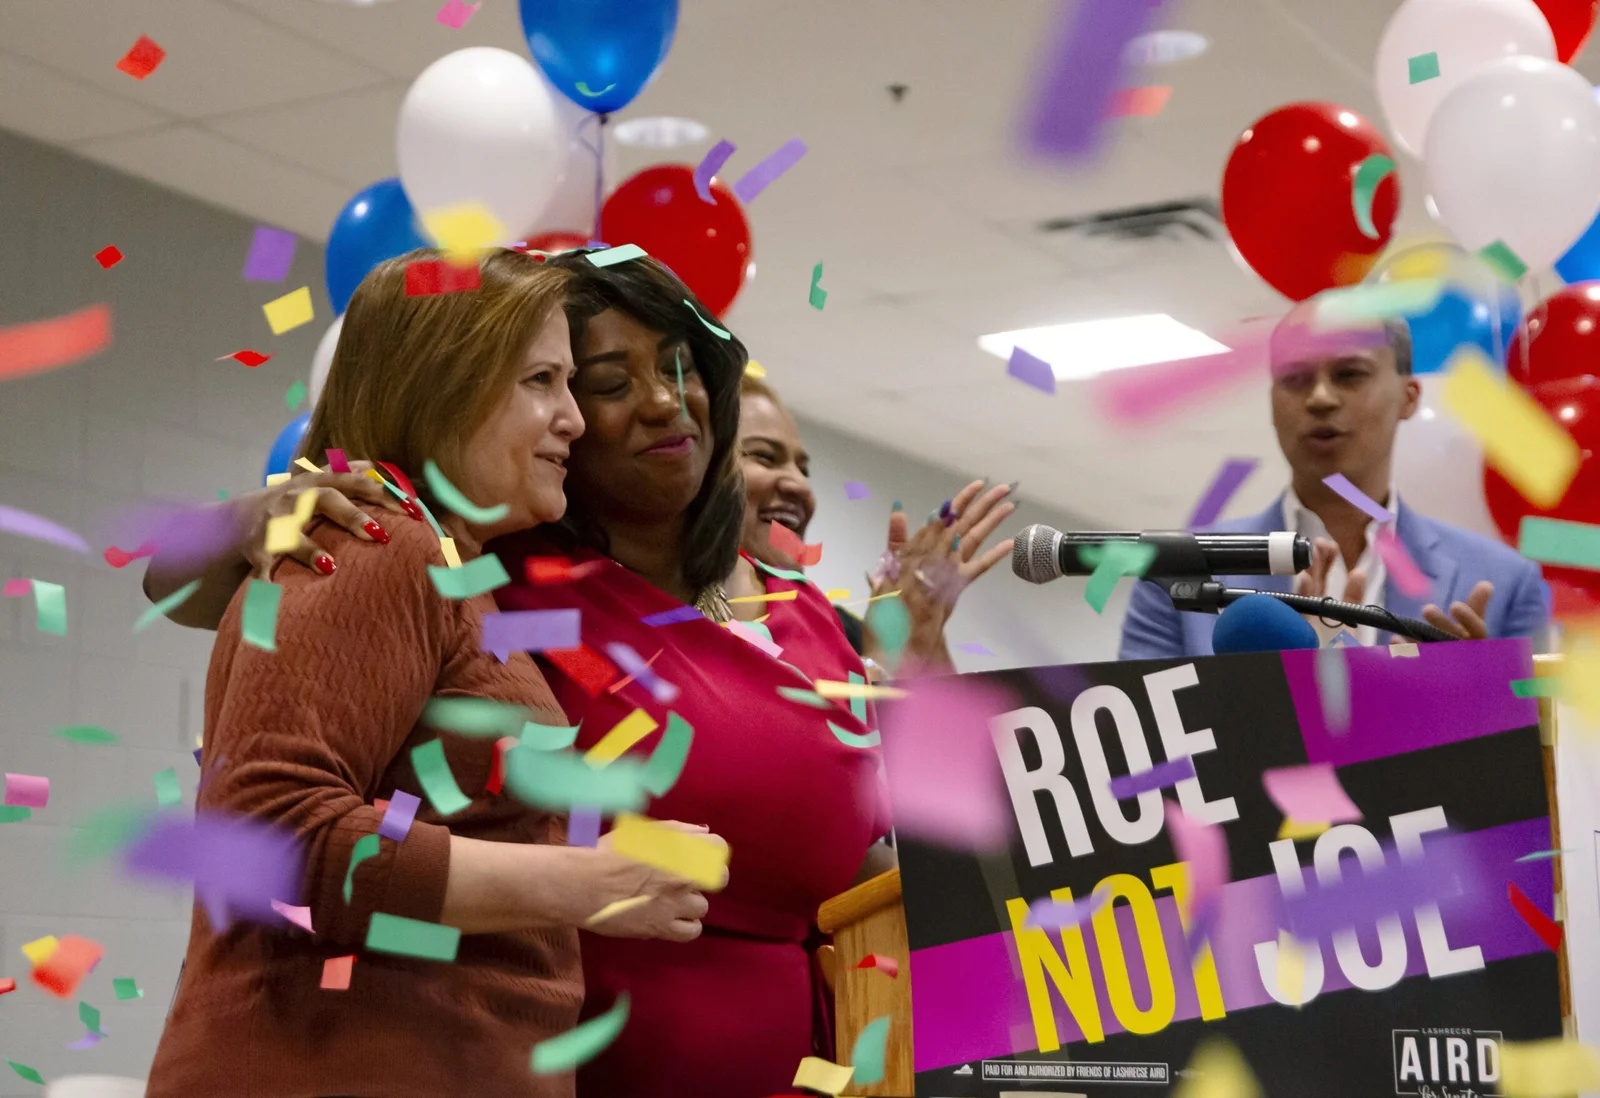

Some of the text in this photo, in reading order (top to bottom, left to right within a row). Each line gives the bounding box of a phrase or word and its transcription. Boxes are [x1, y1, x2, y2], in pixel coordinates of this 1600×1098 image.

[987, 662, 1240, 868] ROE
[1005, 805, 1486, 1054] NOT JOE
[1421, 1027, 1472, 1035] LASHRECSE
[984, 1064, 1000, 1076] PAID
[1000, 1064, 1014, 1077] FOR
[1014, 1064, 1028, 1077] AND
[1028, 1065, 1066, 1077] AUTHORIZED
[1066, 1065, 1076, 1077] BY
[1076, 1065, 1103, 1078] FRIENDS
[1103, 1066, 1112, 1078] OF
[1112, 1066, 1149, 1079] LASHRECSE
[1149, 1067, 1166, 1079] AIRD
[1399, 1036, 1501, 1083] AIRD
